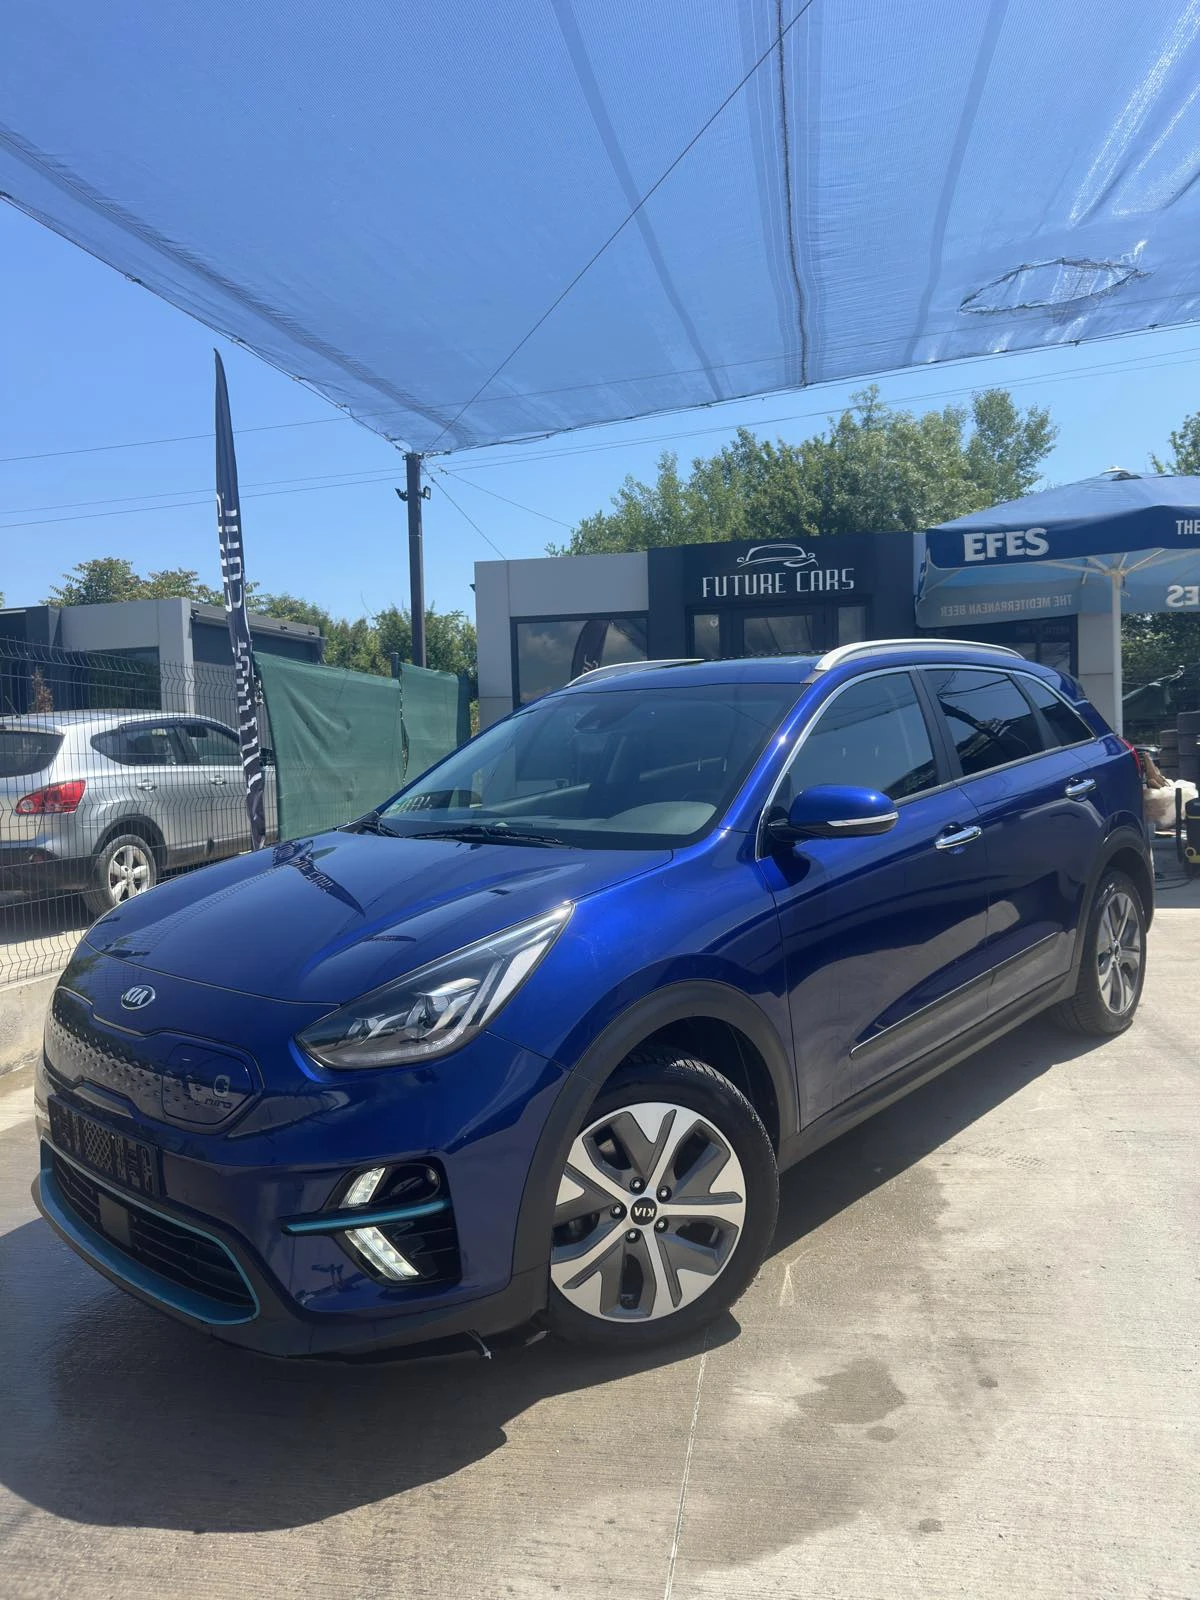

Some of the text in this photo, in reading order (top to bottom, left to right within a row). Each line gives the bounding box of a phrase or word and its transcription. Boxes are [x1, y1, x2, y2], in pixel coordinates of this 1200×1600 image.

[1175, 519, 1200, 535] THE
[963, 527, 1050, 562] EFES
[702, 567, 855, 598] FUTURE CARS
[122, 986, 150, 1006] KIA
[634, 1206, 655, 1218] KIA
